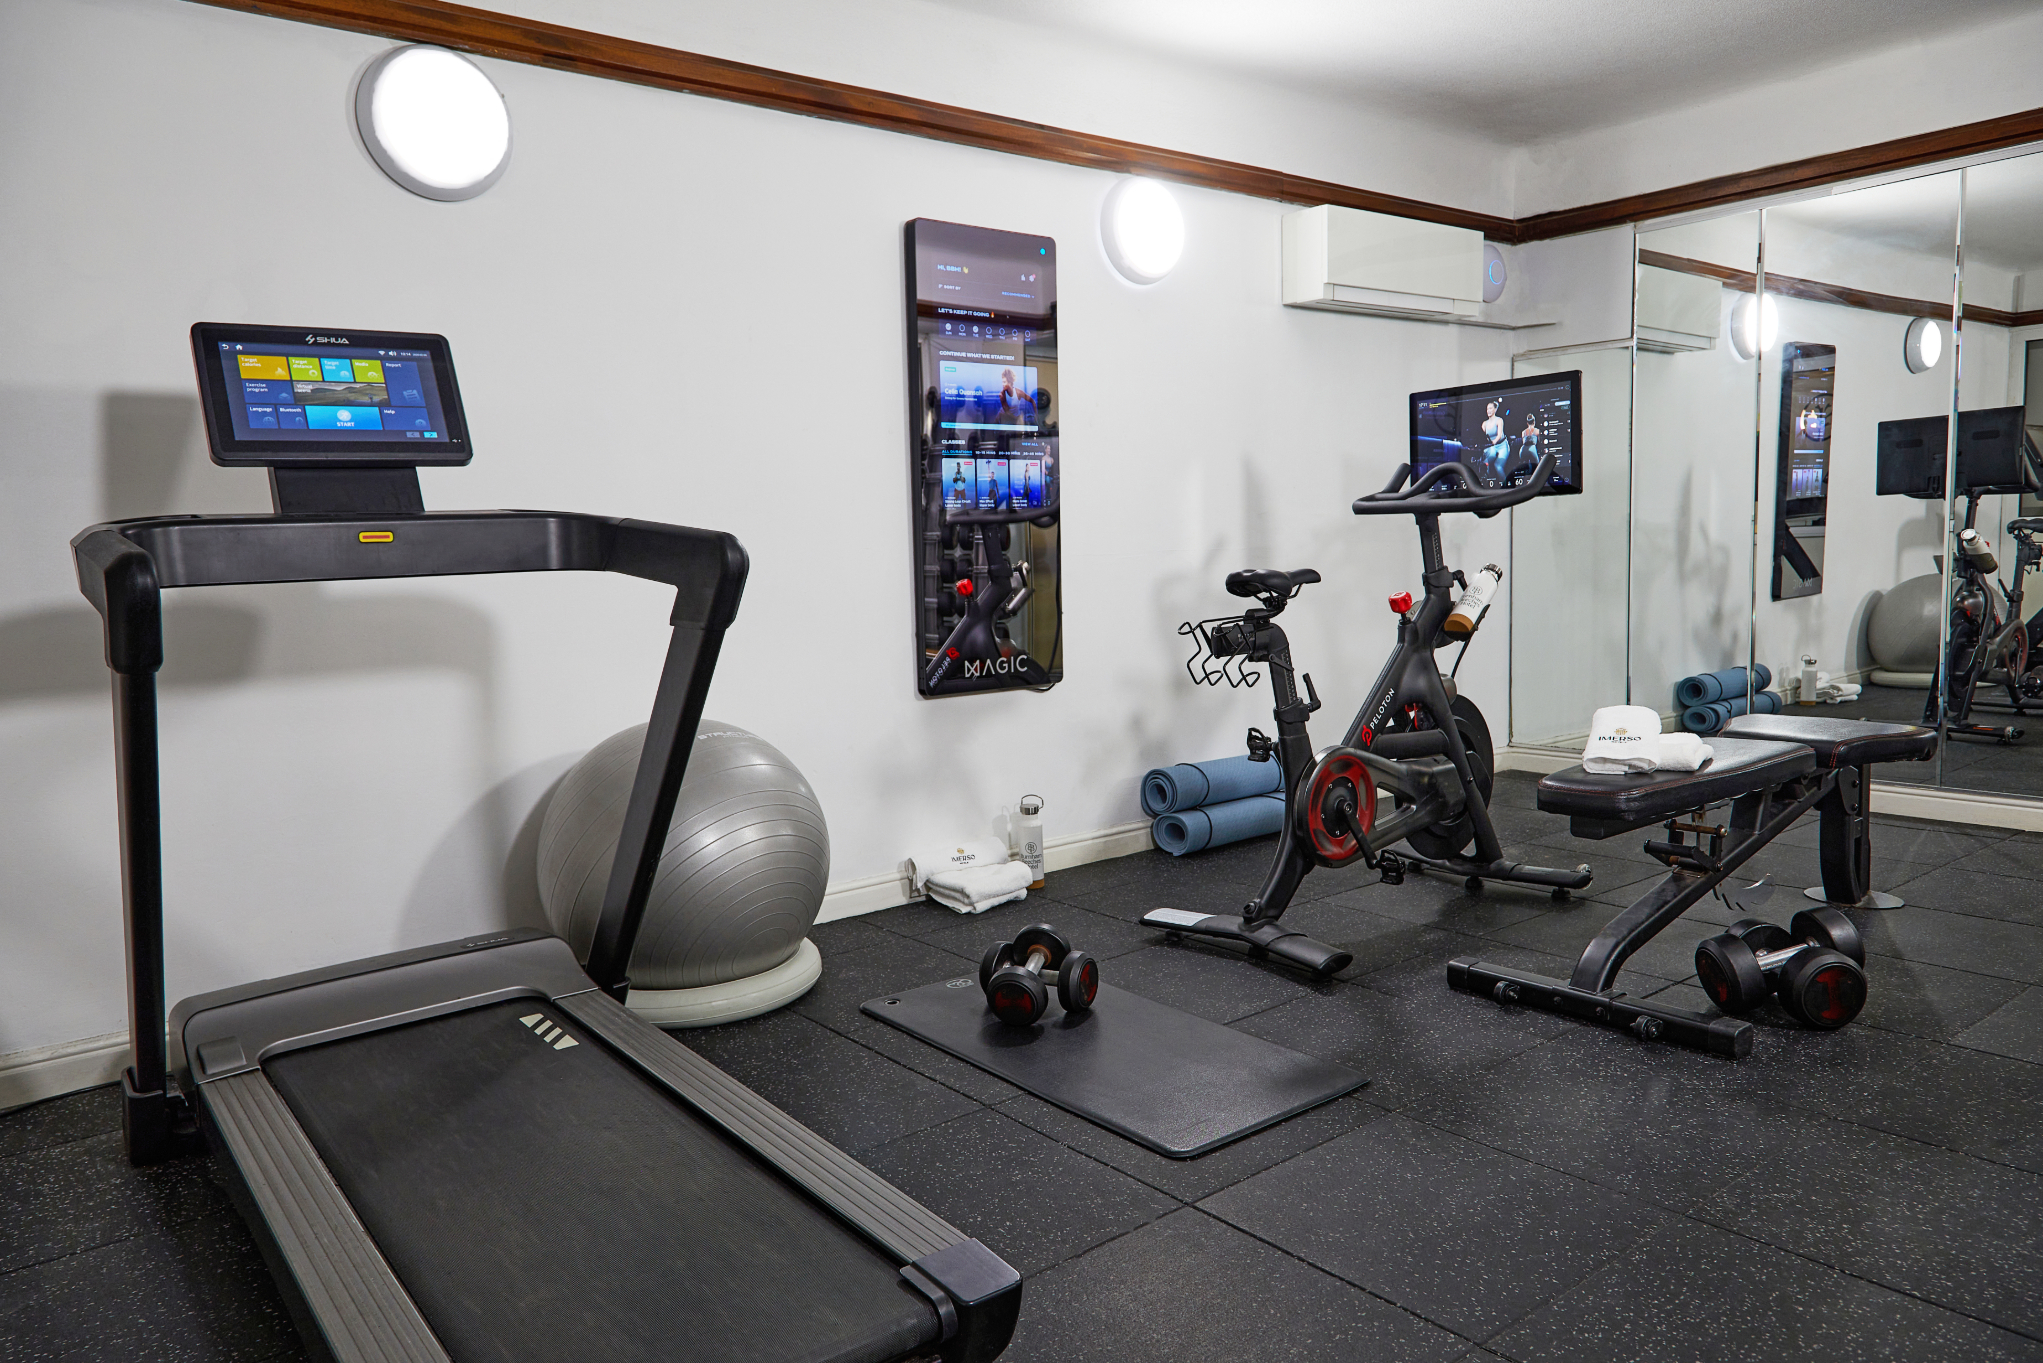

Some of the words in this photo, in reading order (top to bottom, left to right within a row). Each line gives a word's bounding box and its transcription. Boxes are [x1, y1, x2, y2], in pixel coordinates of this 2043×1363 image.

[316, 336, 350, 345] SHUA
[1490, 480, 1494, 488] 0
[1515, 478, 1523, 486] 60
[964, 654, 1028, 678] MAGIC
[1369, 687, 1396, 730] PELOTON
